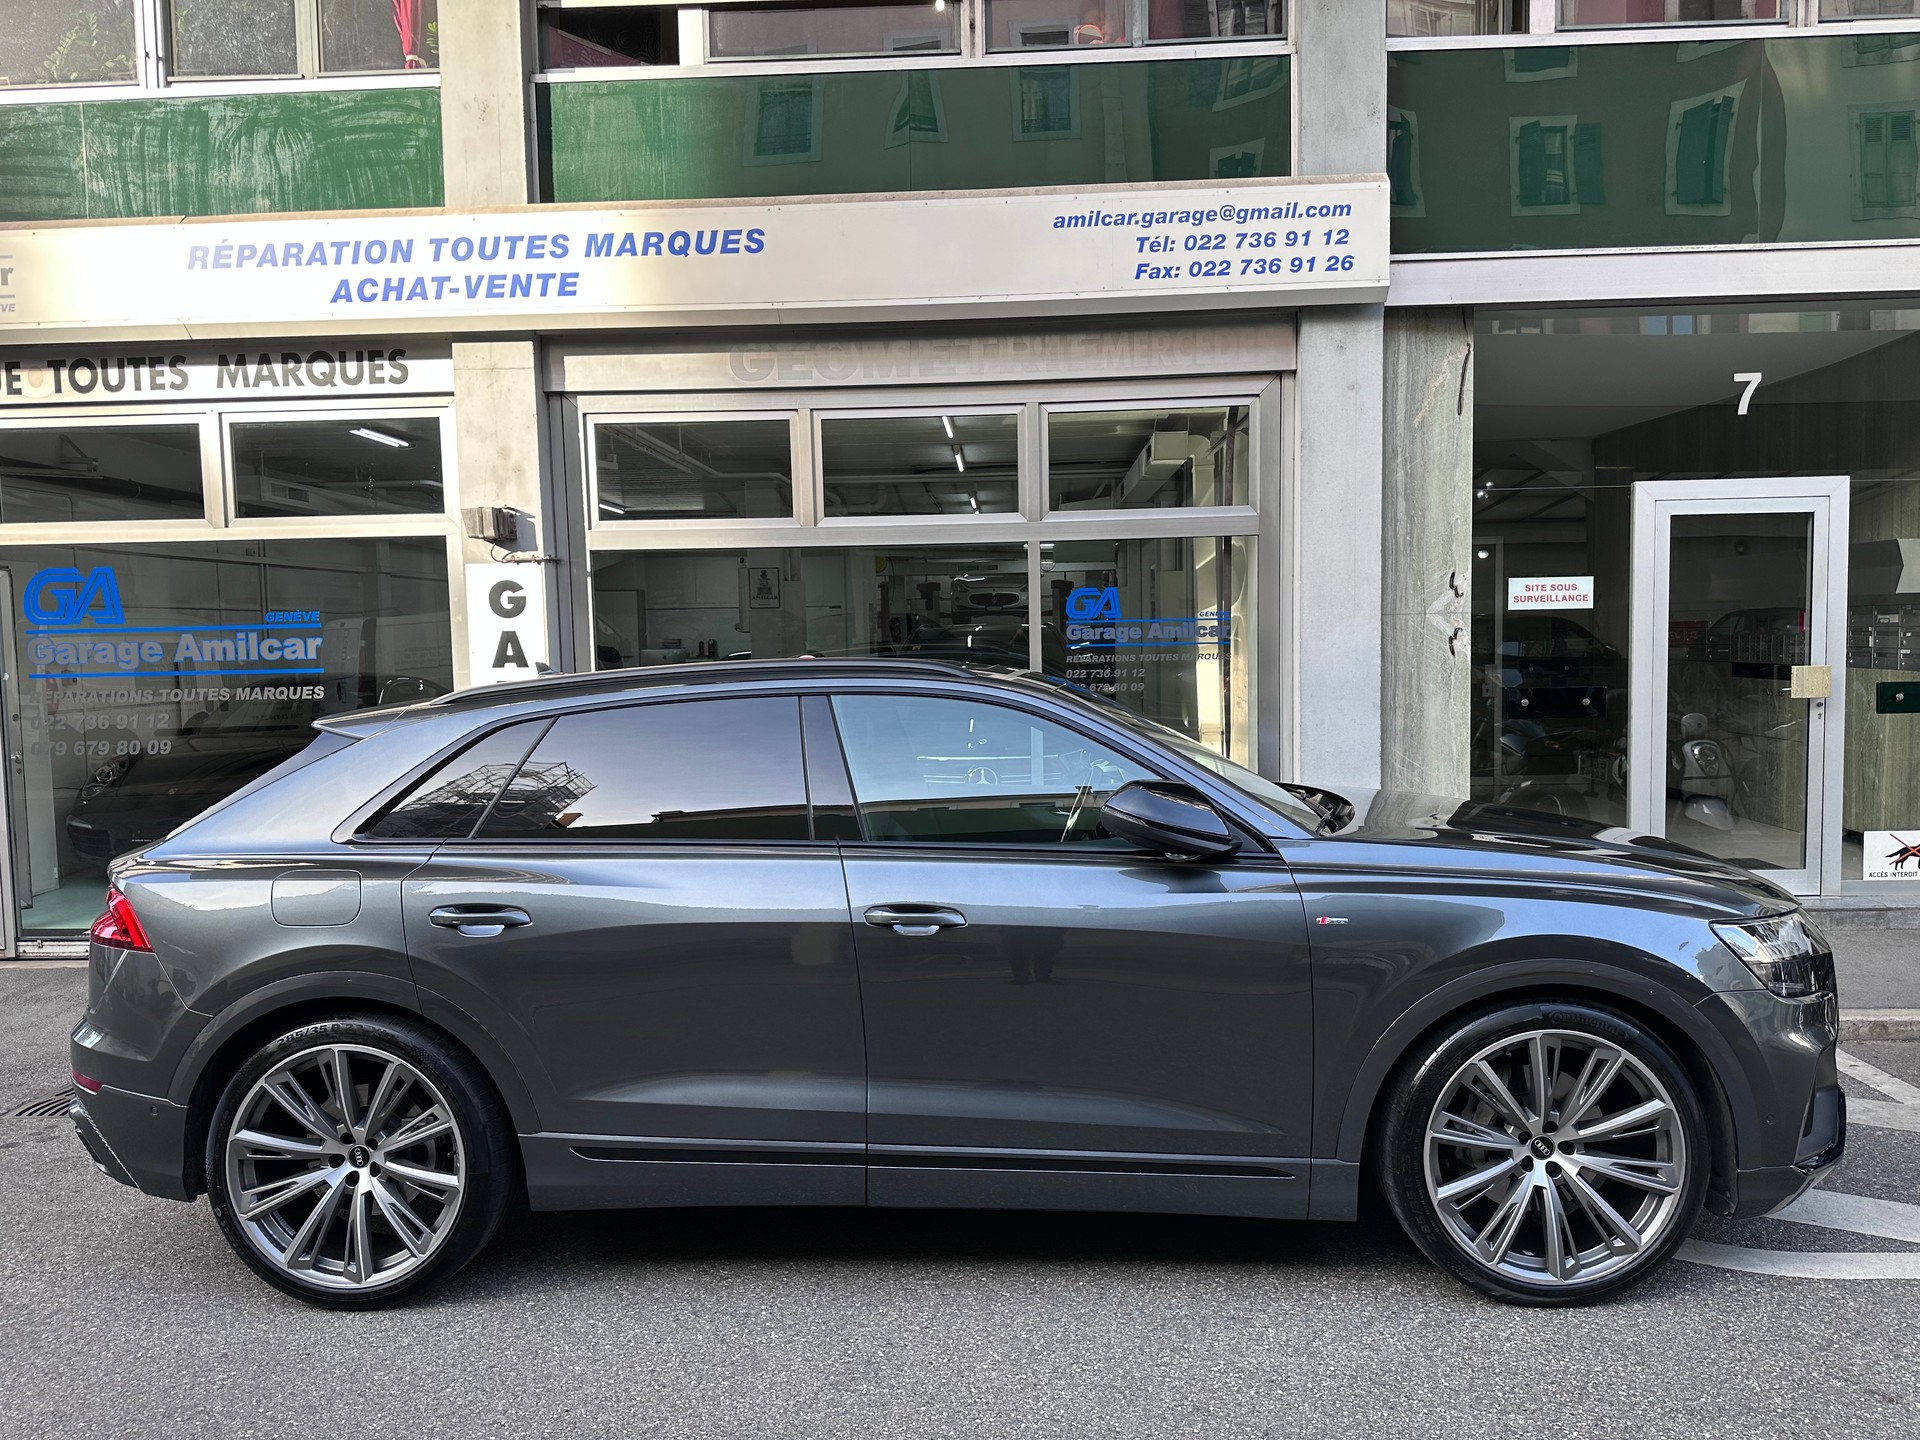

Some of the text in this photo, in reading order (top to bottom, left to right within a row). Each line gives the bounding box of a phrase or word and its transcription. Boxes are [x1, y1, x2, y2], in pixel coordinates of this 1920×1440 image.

[1053, 202, 1352, 229] amilcar.garage@gmail.com
[188, 228, 766, 270] RÉPARATION TOUTES MARQUES
[1136, 228, 1350, 254] Tél: 022 736 91 12
[0, 267, 14, 286] r
[1134, 254, 1355, 280] Fax: 022 736 91 26
[330, 272, 580, 303] ACHAT-VENTE
[0, 348, 410, 396] E TOUTES MARQUES
[1732, 372, 1763, 416] 7
[23, 566, 126, 626] GA
[1513, 594, 1589, 604] SURVEILLANCE
[1524, 583, 1578, 592] SITE SOUS
[1065, 586, 1122, 619] GA
[265, 608, 320, 623] GENÈVE
[488, 580, 530, 683] GA
[1066, 622, 1231, 643] Garage Amilcar
[25, 634, 164, 671] Garage
[173, 630, 323, 663] Amilcar
[1139, 652, 1179, 662] TOUTES
[1181, 652, 1233, 661] MARQUES
[1066, 668, 1146, 679] 022 736 91 12
[158, 687, 231, 701] TOUTES
[235, 685, 325, 701] MARQUES
[1130, 682, 1145, 692] 09
[31, 712, 170, 731] 022 736 91 12
[73, 740, 110, 756] 679
[116, 739, 141, 755] 80
[147, 739, 172, 755] 09
[276, 1024, 329, 1047] 285/35
